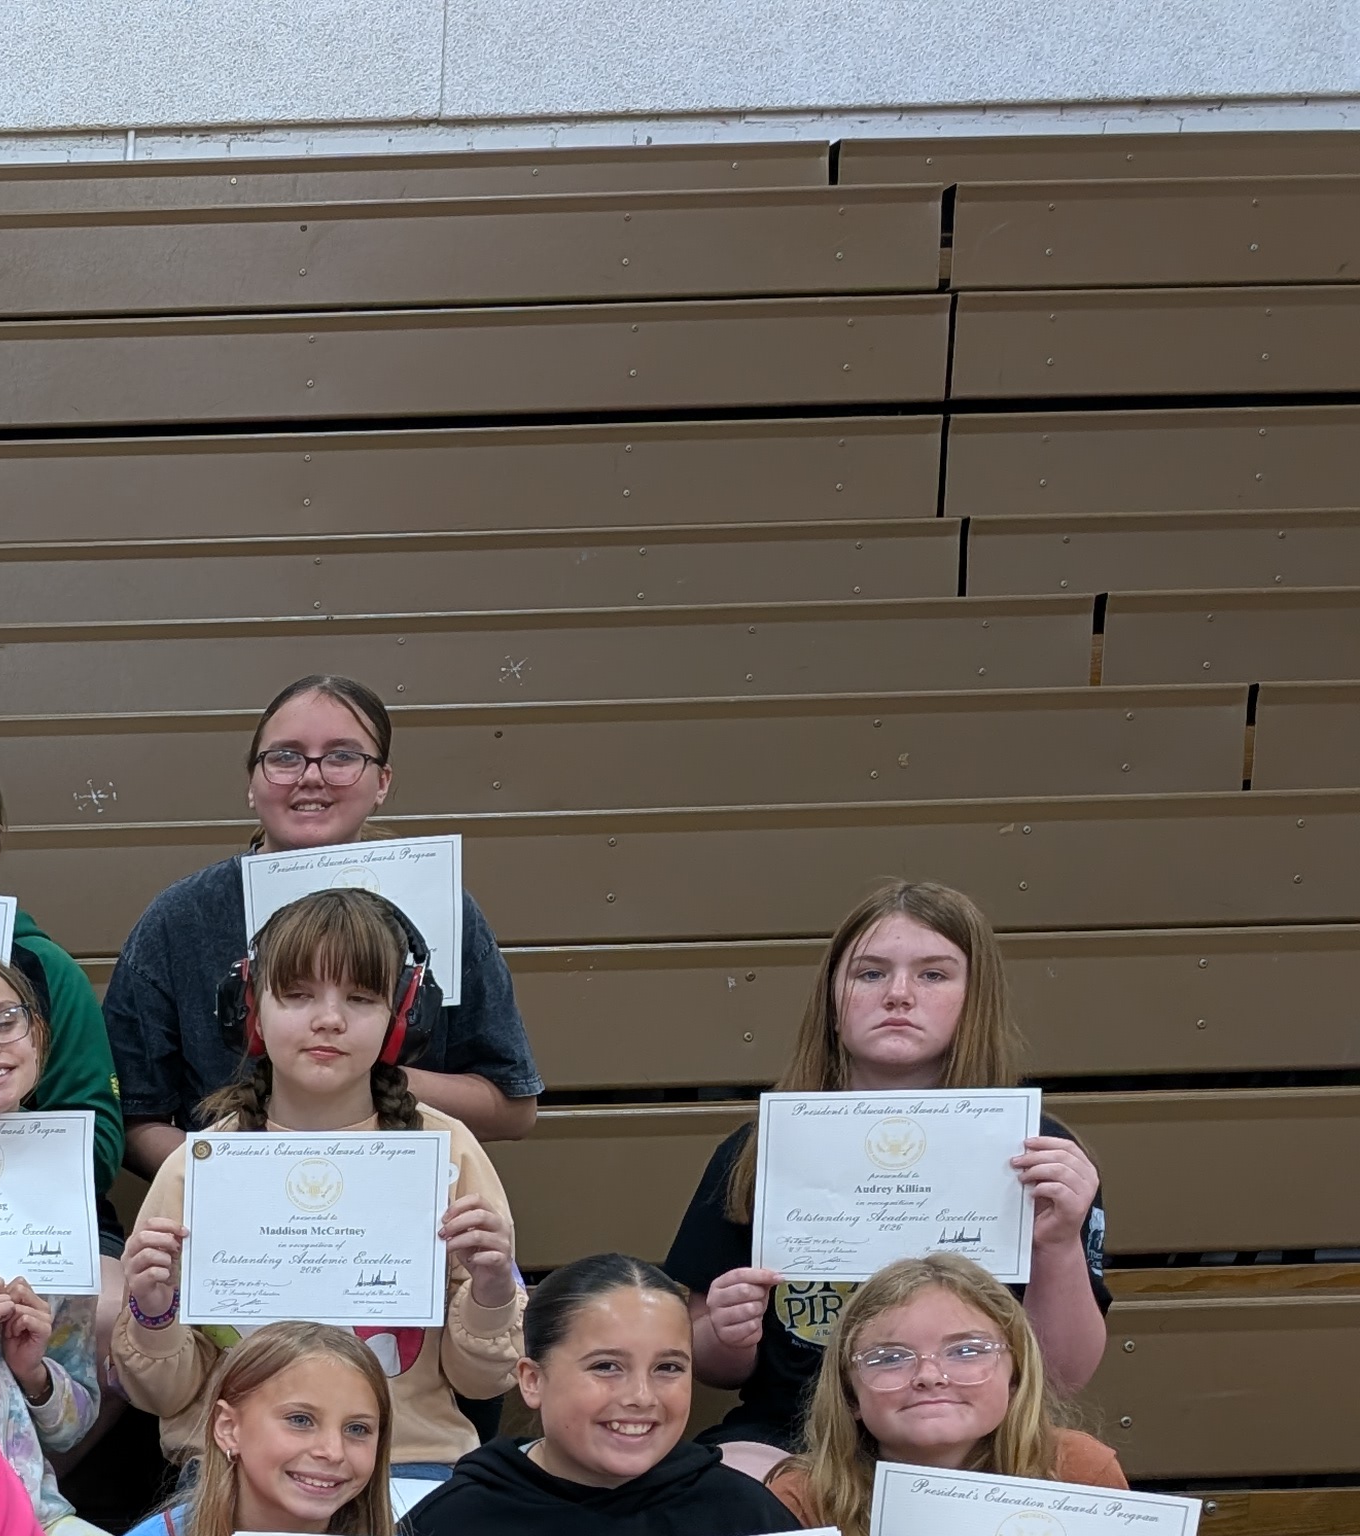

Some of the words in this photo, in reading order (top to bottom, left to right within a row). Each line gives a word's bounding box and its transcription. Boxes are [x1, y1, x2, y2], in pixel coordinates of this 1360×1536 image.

[268, 860, 314, 874] President's
[317, 856, 358, 868] Education
[361, 850, 396, 864] Awards
[400, 847, 436, 864] Program
[792, 1101, 848, 1116] President's
[852, 1101, 903, 1115] Education
[905, 1100, 949, 1114] Awards
[954, 1099, 1004, 1118] Program
[28, 1120, 66, 1139] Program
[215, 1141, 269, 1156] President's
[273, 1142, 321, 1156] Education
[323, 1141, 364, 1156] Awards
[368, 1140, 416, 1160] Program
[854, 1184, 893, 1195] Audrey
[895, 1184, 931, 1193] Killian
[259, 1226, 307, 1235] Maddison
[310, 1226, 364, 1237] McCartney
[784, 1295, 842, 1329] PIR
[911, 1477, 978, 1500] President's
[984, 1486, 1044, 1508] Education
[1047, 1494, 1098, 1515] Awards
[1102, 1500, 1159, 1526] Program
